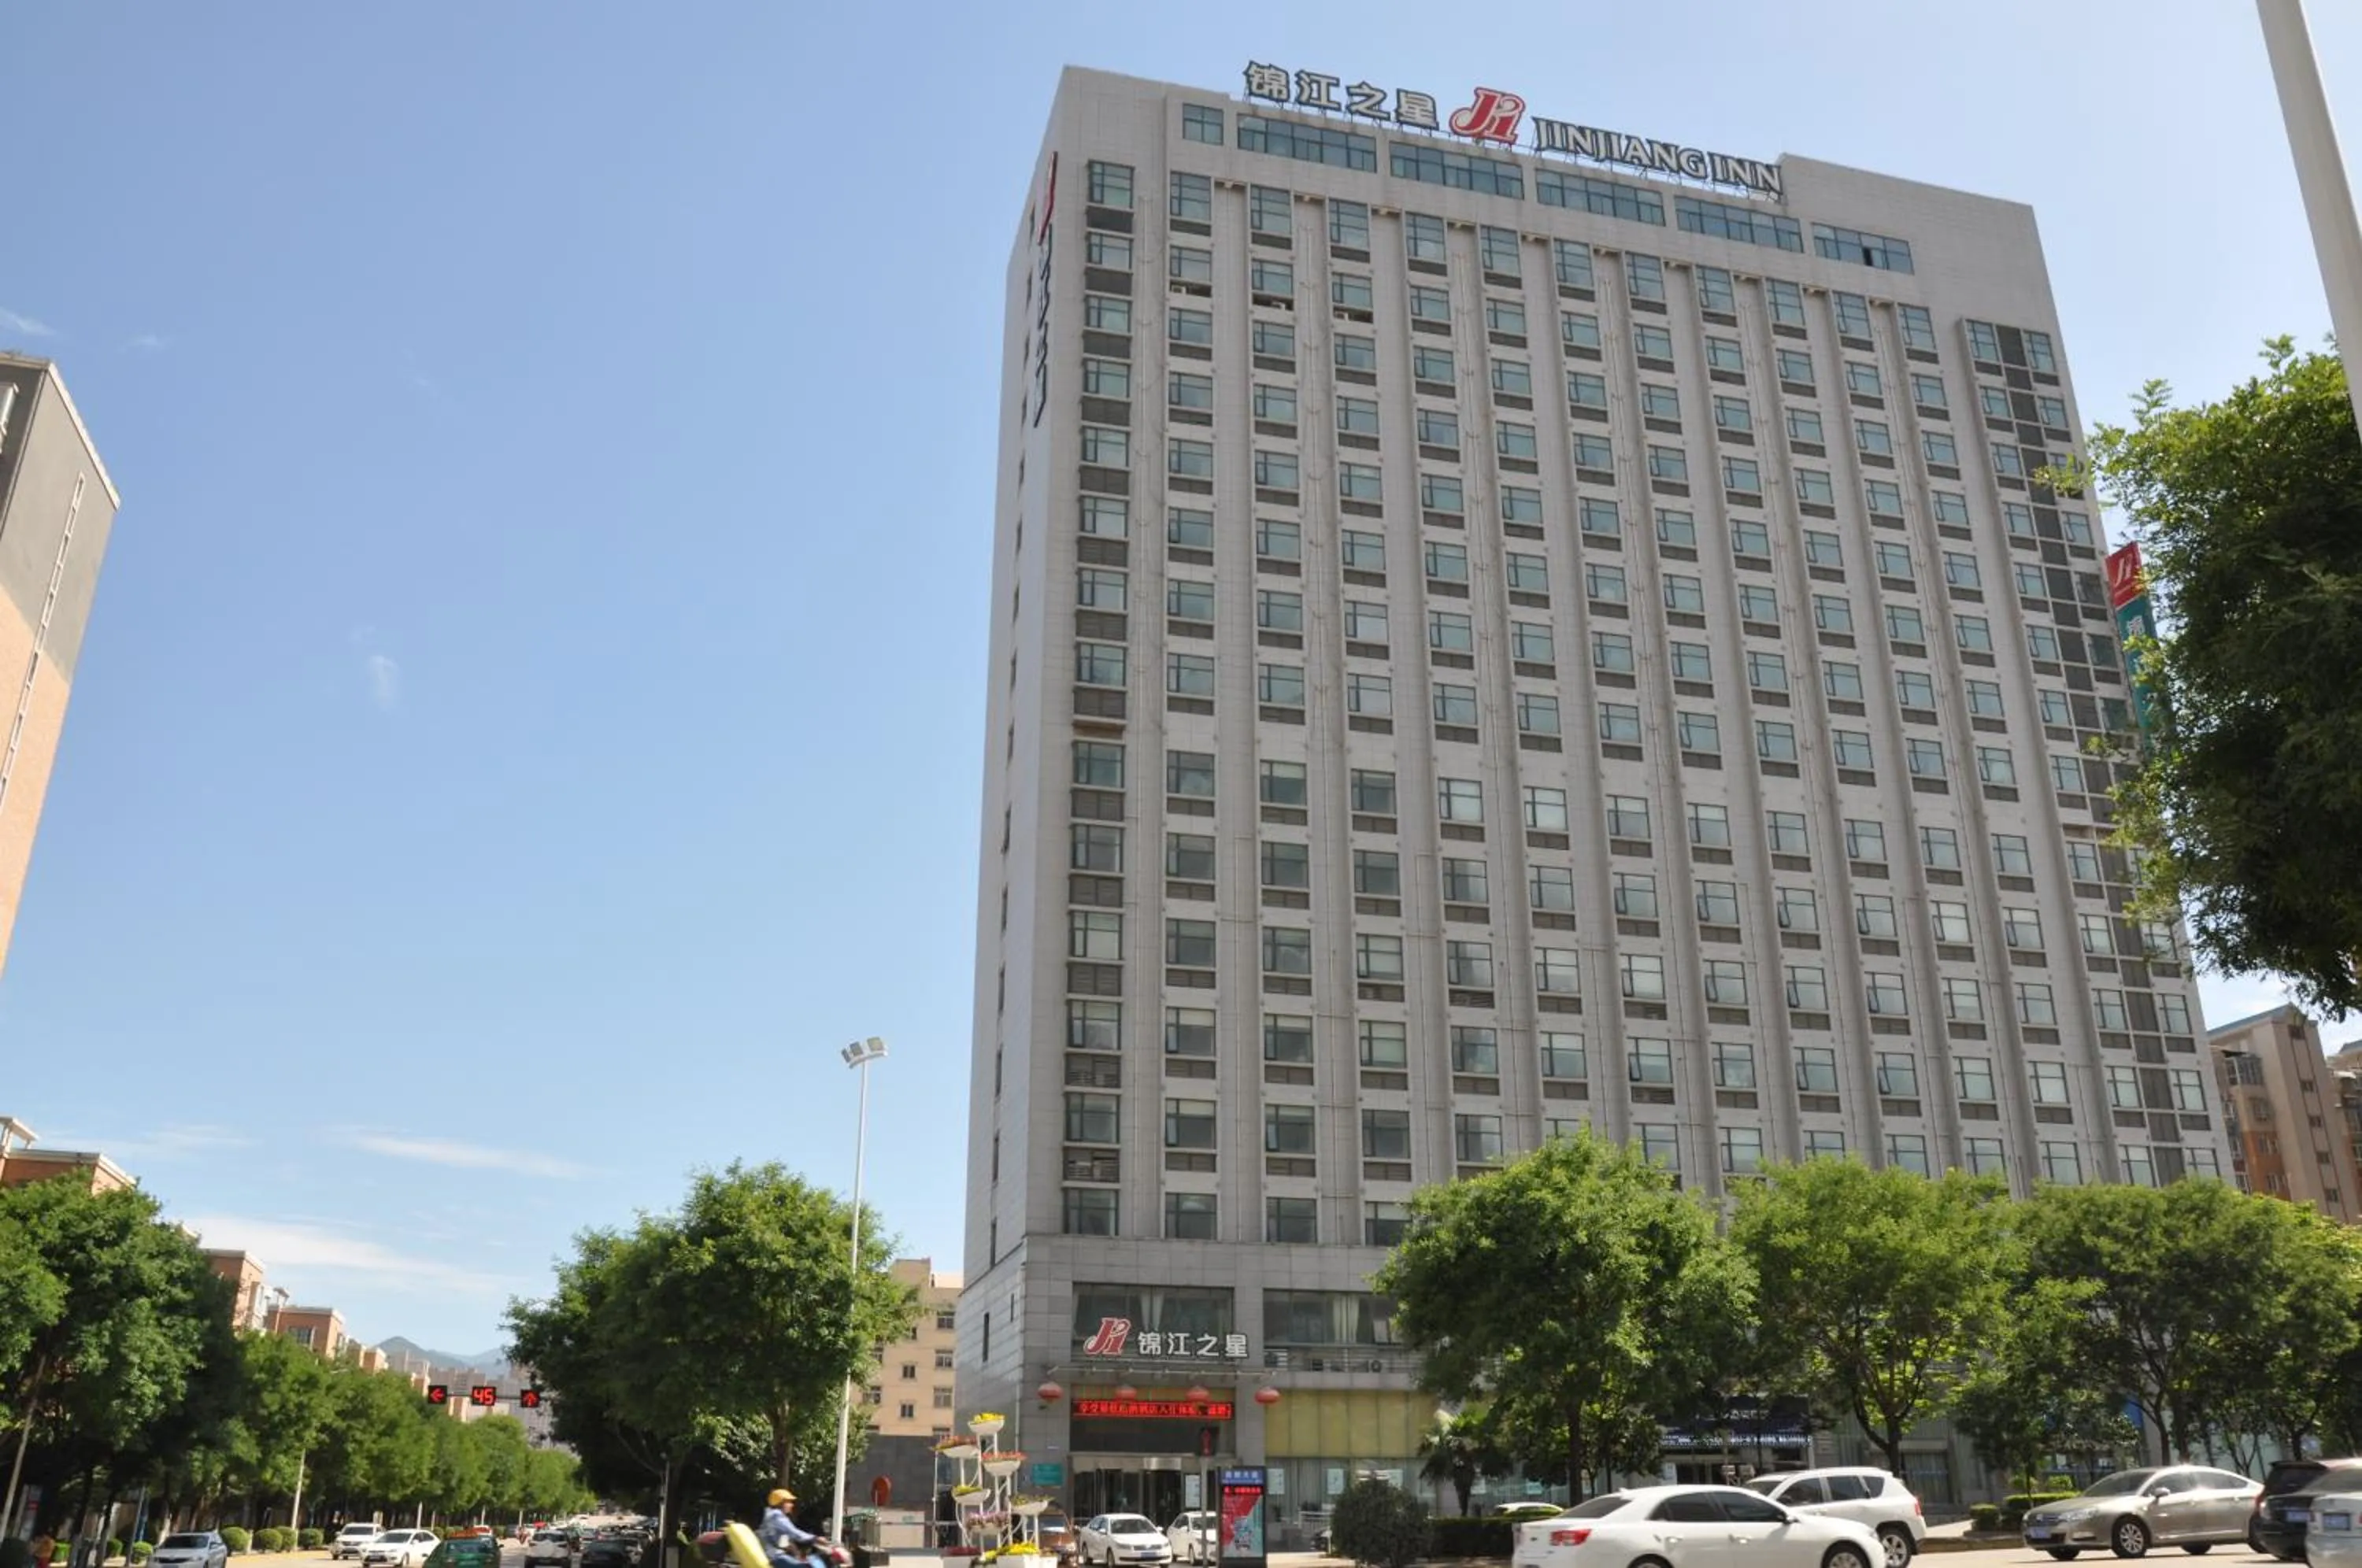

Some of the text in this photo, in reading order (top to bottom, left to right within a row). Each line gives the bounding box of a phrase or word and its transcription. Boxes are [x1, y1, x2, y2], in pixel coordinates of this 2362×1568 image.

[1243, 60, 1439, 130] 锦江之星
[1532, 116, 1783, 194] JINJIANG INN
[1138, 1332, 1248, 1358] 锦江之星
[473, 1387, 494, 1405] 45
